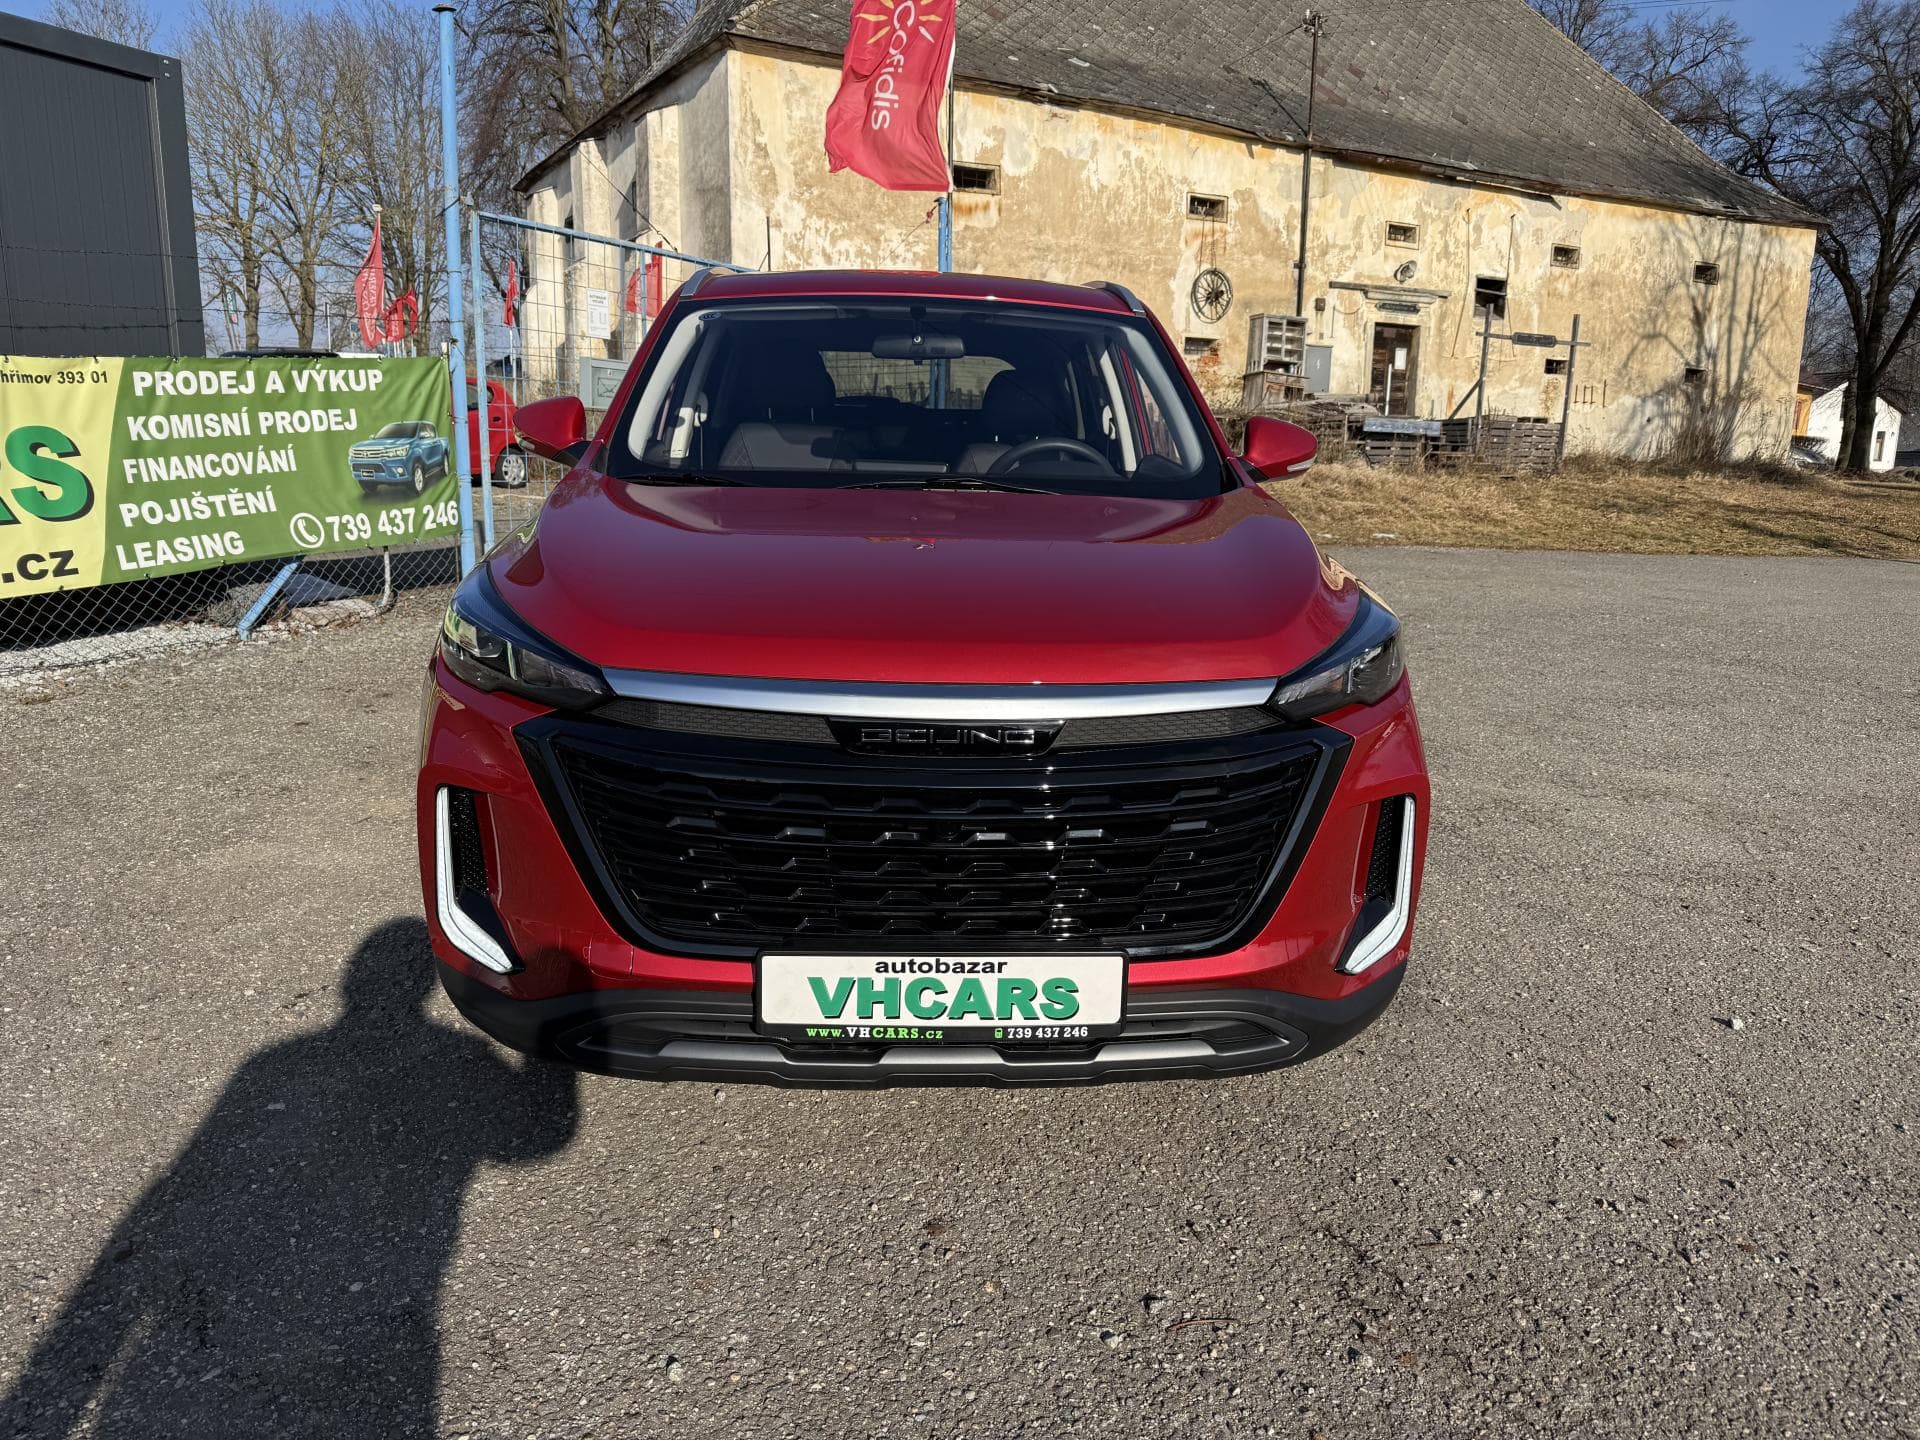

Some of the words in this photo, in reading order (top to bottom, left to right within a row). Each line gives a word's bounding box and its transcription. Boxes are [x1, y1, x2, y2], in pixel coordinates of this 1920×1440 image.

[871, 0, 915, 130] Cofidis
[57, 371, 85, 384] 393
[91, 371, 108, 383] 01
[132, 370, 255, 396] PRODEJ
[265, 371, 285, 393] A
[292, 364, 383, 393] VÝKUP
[127, 407, 251, 441] KOMISNÍ
[258, 408, 358, 435] PRODEJ
[123, 444, 297, 484] FINANCOVÁNÍ
[119, 485, 277, 527] POJIŠTĚNÍ
[325, 513, 372, 542] 739
[378, 508, 416, 536] 437
[422, 500, 459, 531] 246
[115, 531, 245, 570] LEASING
[874, 958, 1008, 974] autobazar
[807, 976, 1080, 1021] VHCARS
[806, 1027, 944, 1040] www.VHCARS.cz
[1007, 1027, 1032, 1039] 739
[1035, 1027, 1060, 1039] 437
[1063, 1026, 1089, 1038] 246
